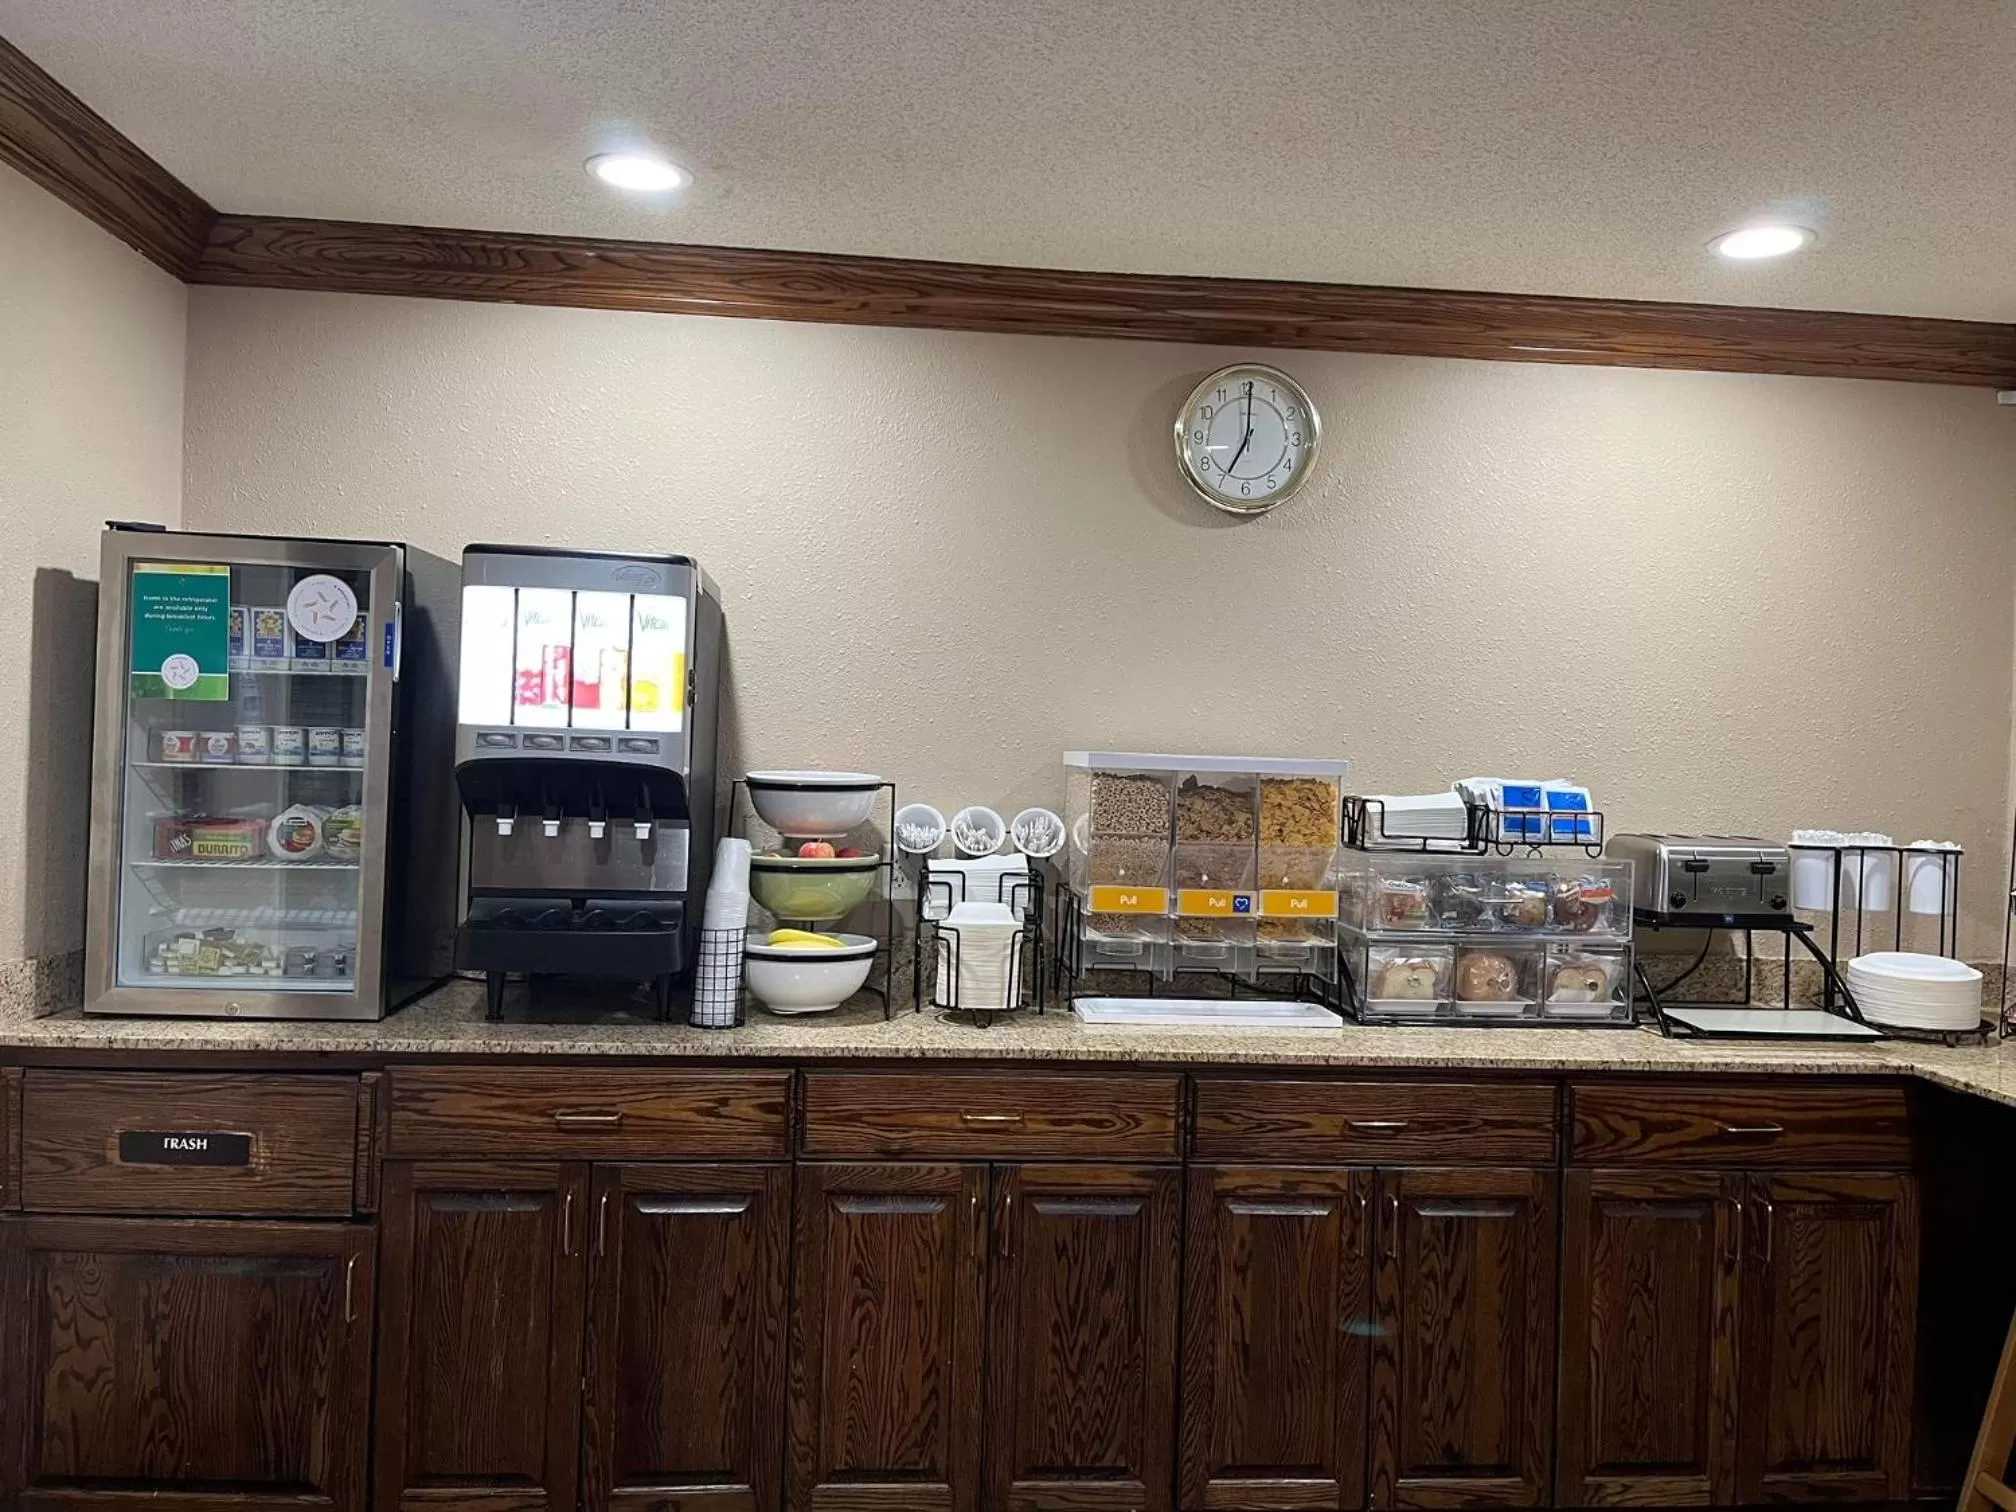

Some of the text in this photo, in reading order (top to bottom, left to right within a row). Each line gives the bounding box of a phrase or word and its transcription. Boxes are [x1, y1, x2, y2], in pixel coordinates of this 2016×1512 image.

[1216, 389, 1227, 402] 11
[1241, 382, 1254, 395] 12
[1270, 389, 1277, 402] 1
[1200, 405, 1213, 420] 10
[1286, 406, 1295, 421] 2
[1194, 430, 1204, 445] 9
[1291, 432, 1301, 447] 3
[1200, 456, 1210, 471] 8
[1283, 458, 1291, 472] 4
[1217, 473, 1227, 488] 7
[1266, 474, 1277, 490] 5
[1241, 481, 1251, 496] 6
[198, 843, 249, 856] BURRITO
[1119, 895, 1138, 905] Pull
[1208, 897, 1227, 908] Pull
[1290, 898, 1308, 909] Pull
[163, 1137, 208, 1150] TRASH
